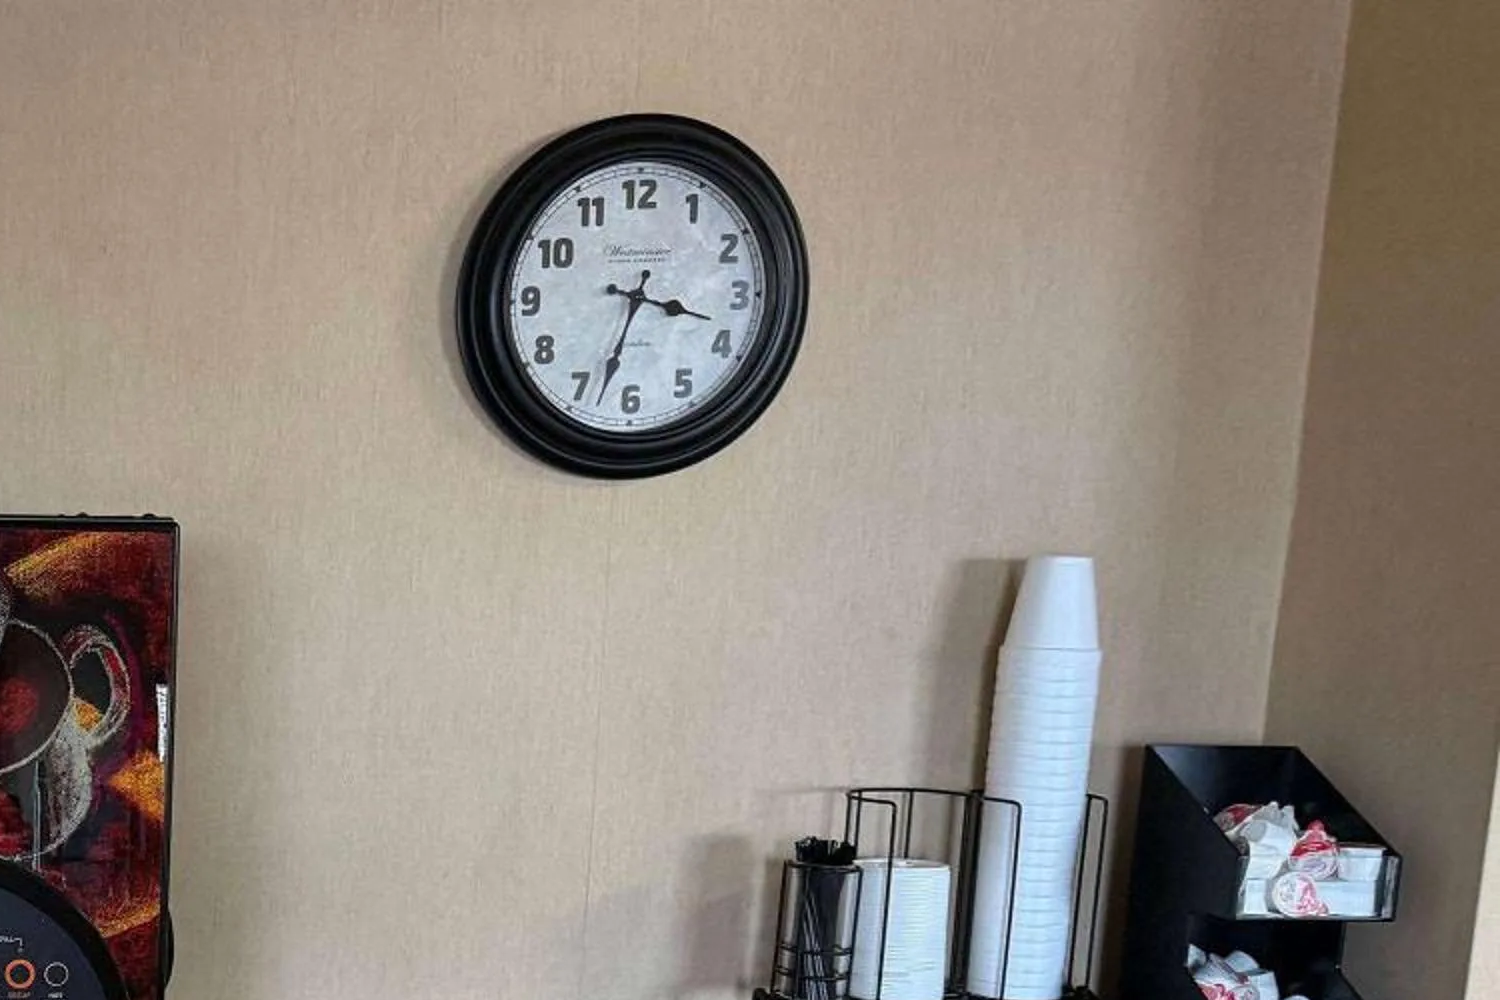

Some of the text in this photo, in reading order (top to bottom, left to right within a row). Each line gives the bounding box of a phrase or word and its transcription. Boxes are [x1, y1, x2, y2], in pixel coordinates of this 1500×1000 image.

[622, 179, 657, 210] 12
[686, 194, 700, 224] 1
[577, 197, 605, 227] 11
[538, 237, 574, 268] 10
[719, 233, 739, 264] 2
[521, 286, 541, 316] 9
[729, 280, 750, 311] 3
[534, 335, 555, 364] 8
[711, 329, 733, 358] 4
[571, 371, 591, 401] 7
[673, 368, 693, 399] 5
[621, 384, 641, 414] 6
